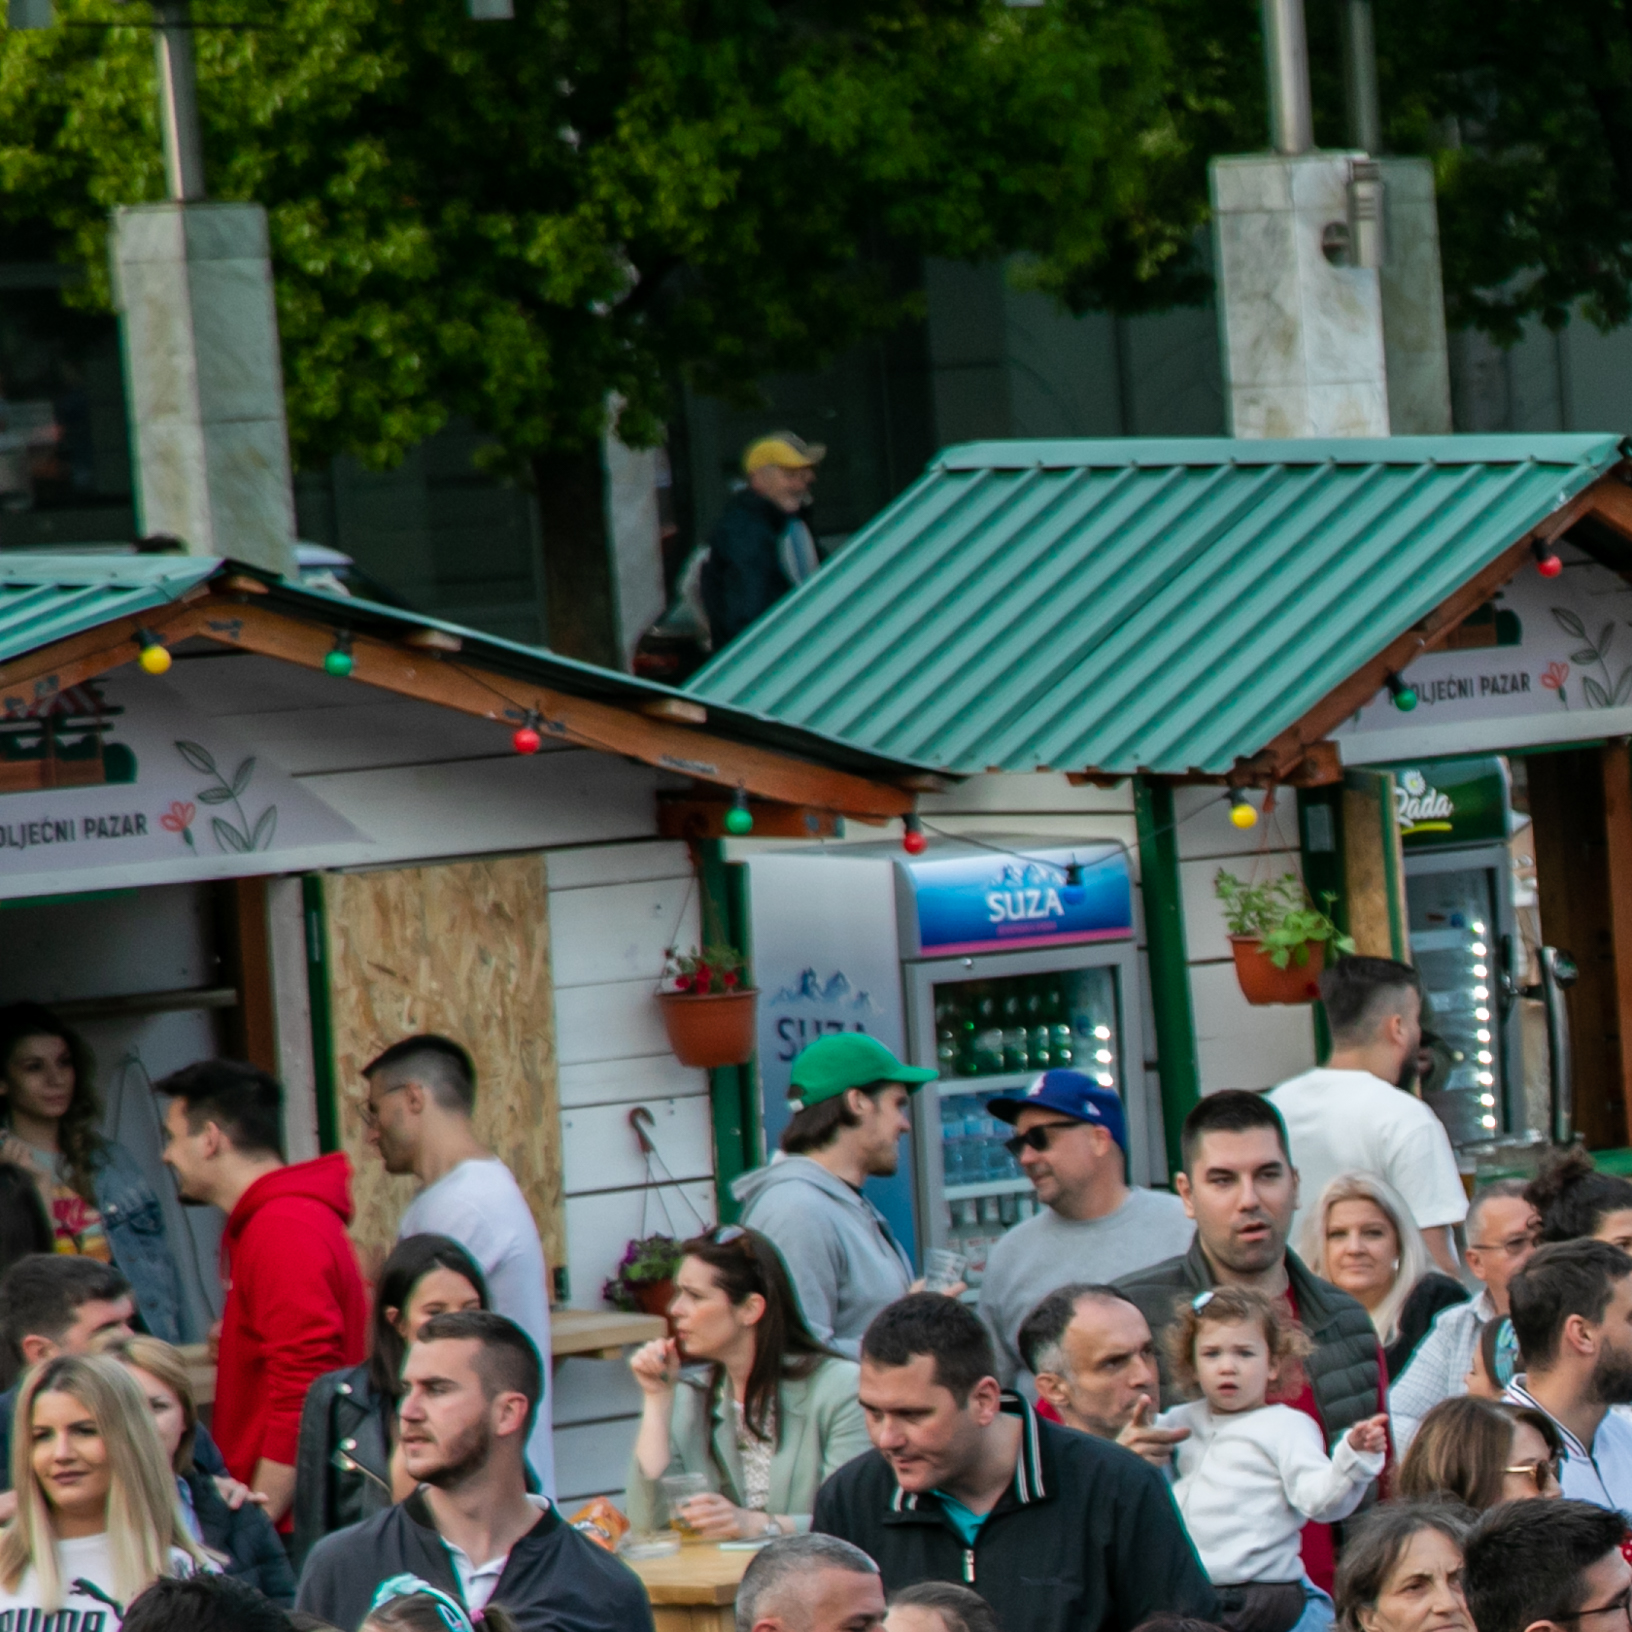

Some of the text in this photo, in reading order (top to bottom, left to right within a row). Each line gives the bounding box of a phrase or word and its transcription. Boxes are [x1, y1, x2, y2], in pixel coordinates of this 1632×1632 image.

[1480, 673, 1531, 696] PAZAR
[0, 812, 148, 850] OLJEĆNI PAZAR
[987, 887, 1065, 924] SUZA
